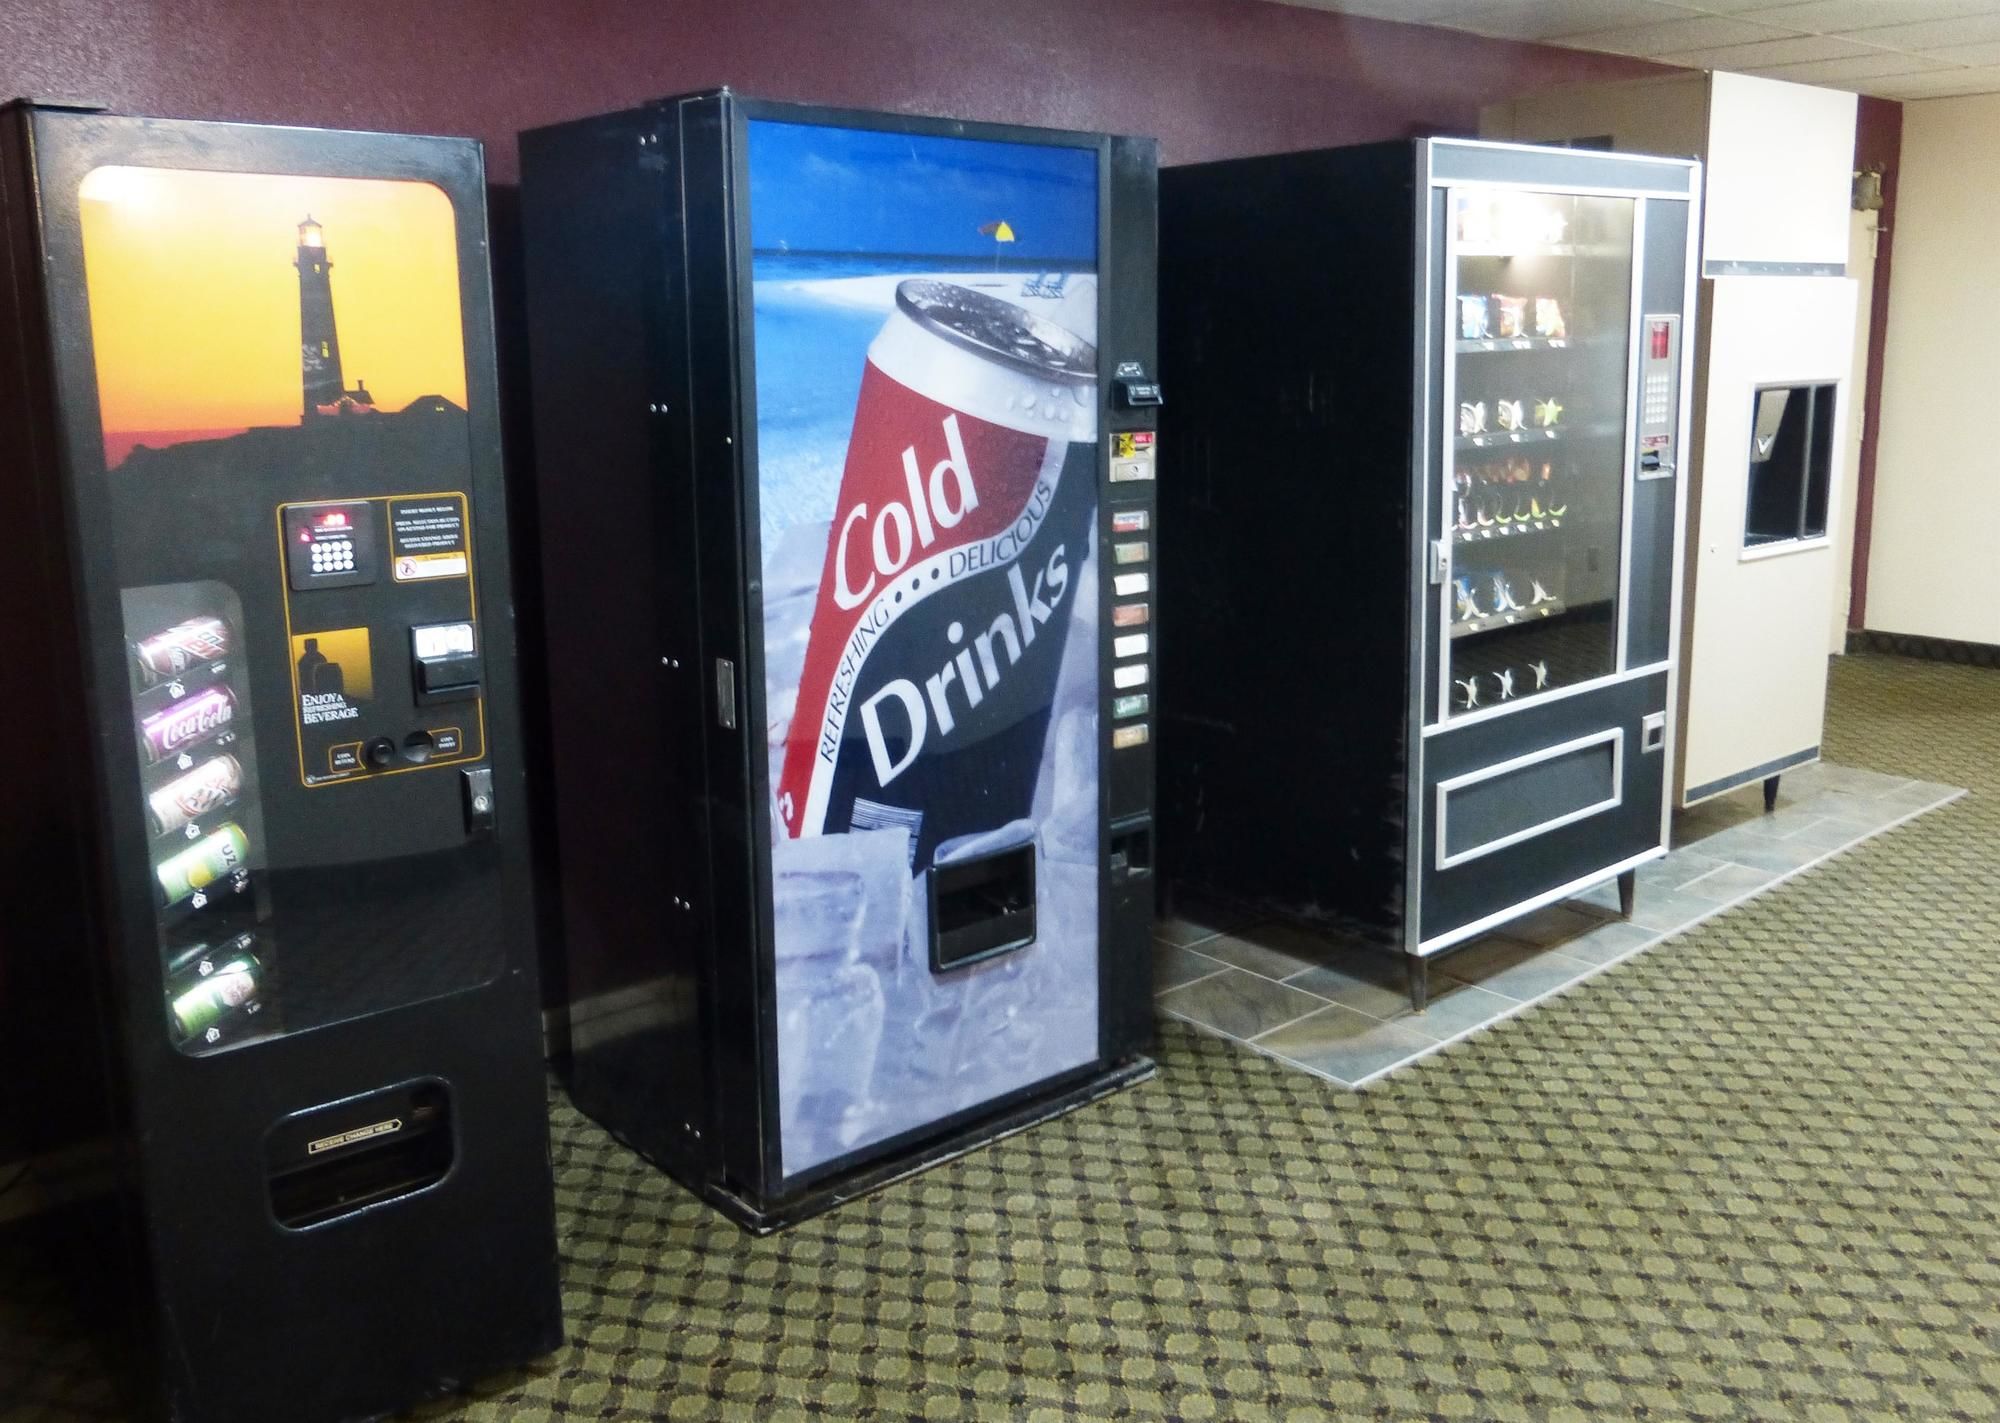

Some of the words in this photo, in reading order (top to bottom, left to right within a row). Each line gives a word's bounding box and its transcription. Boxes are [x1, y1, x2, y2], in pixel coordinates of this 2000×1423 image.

[834, 413, 979, 610] Cold
[303, 707, 359, 724] BEVERAGE
[820, 599, 890, 764] REFRESHING
[949, 480, 1051, 578] DELICIOUS
[860, 544, 1069, 787] Drinks
